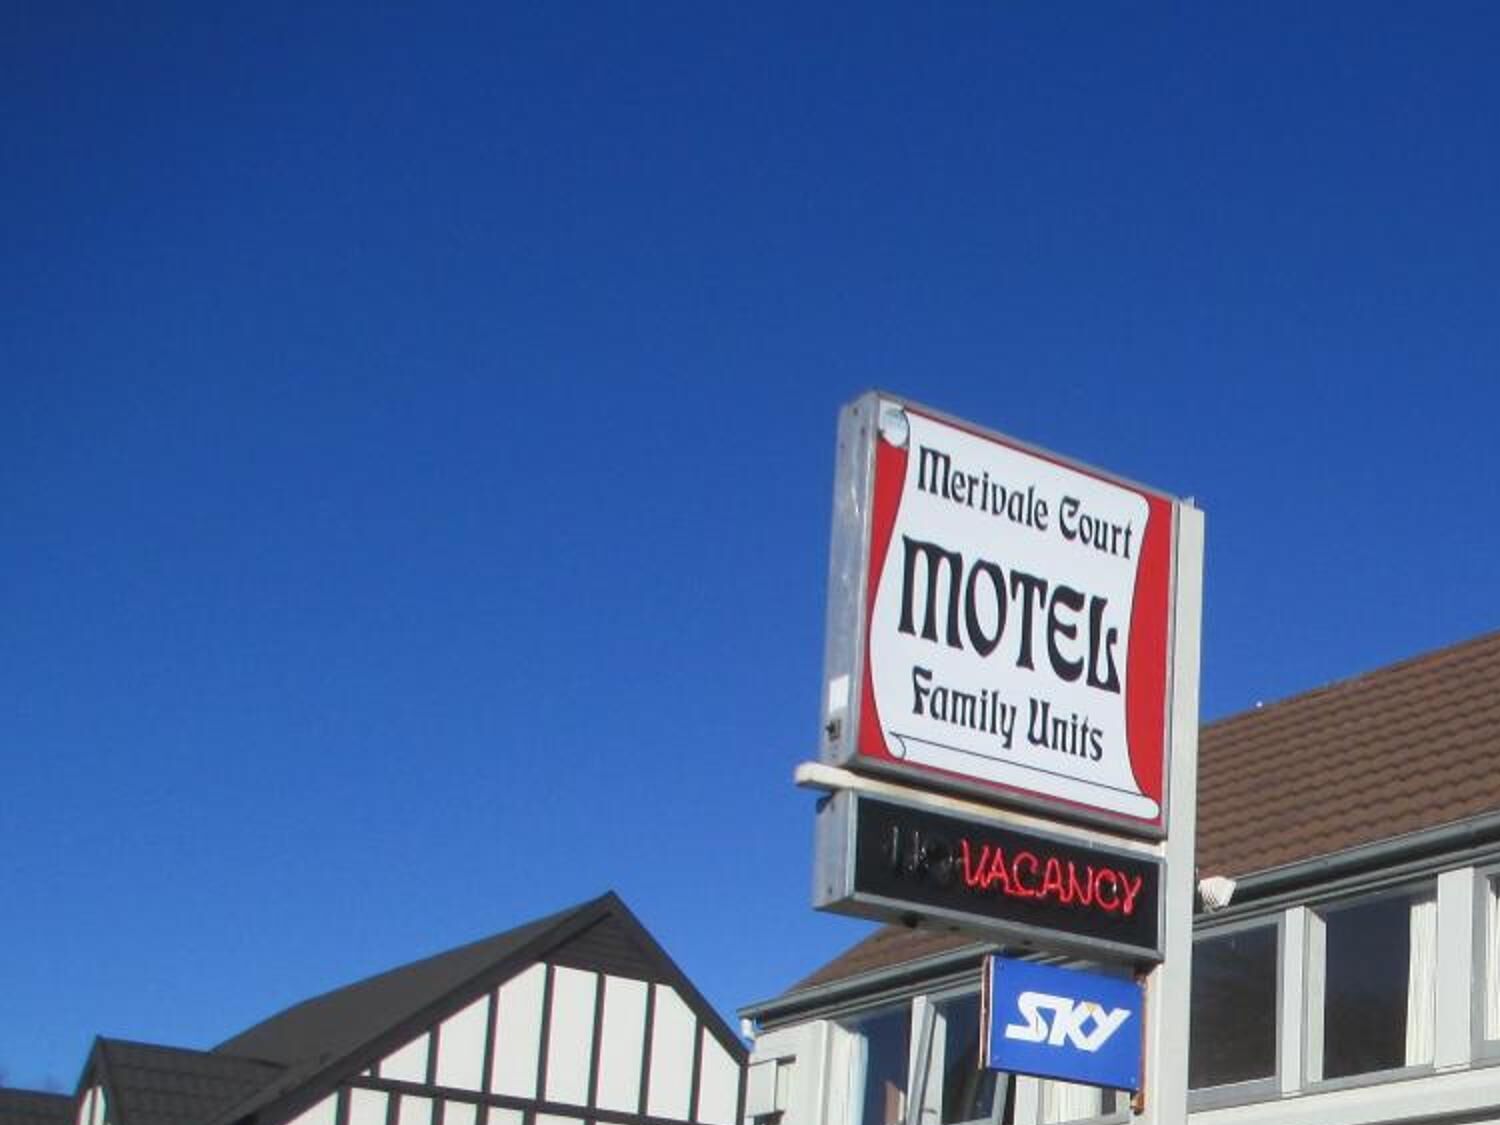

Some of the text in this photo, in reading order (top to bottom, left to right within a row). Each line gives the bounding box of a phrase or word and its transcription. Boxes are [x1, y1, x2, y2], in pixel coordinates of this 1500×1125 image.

[918, 445, 1136, 559] Merivale Court
[897, 534, 1121, 694] MOTEL
[911, 666, 1104, 762] Family Units
[961, 838, 1142, 916] VACANCY
[1004, 990, 1131, 1053] SKY
